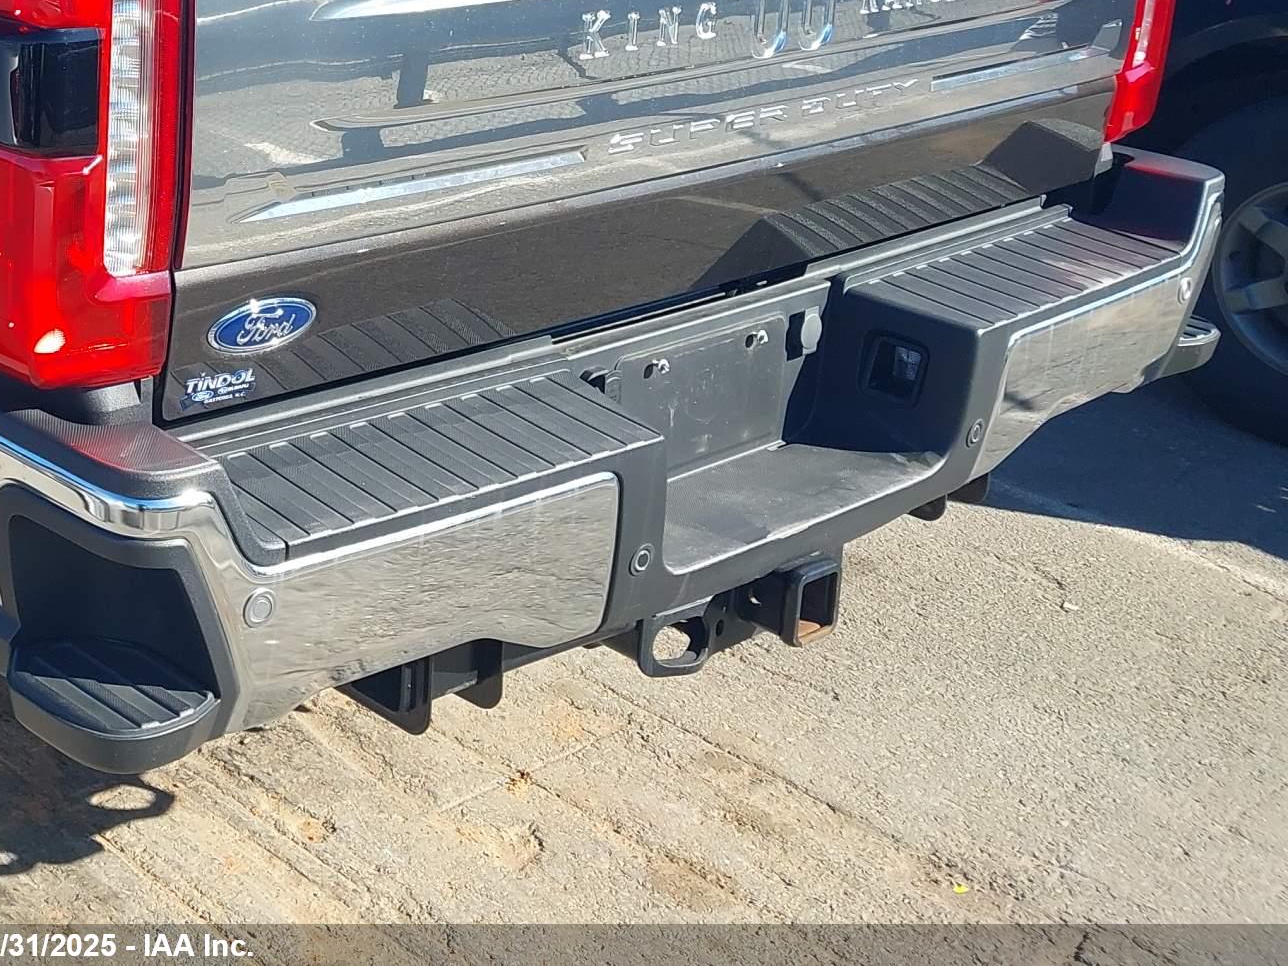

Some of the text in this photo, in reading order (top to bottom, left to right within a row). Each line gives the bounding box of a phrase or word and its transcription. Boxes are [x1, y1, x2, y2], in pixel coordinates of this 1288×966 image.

[579, 1, 718, 60] KING
[608, 104, 788, 154] SUPER
[236, 308, 296, 346] Ford
